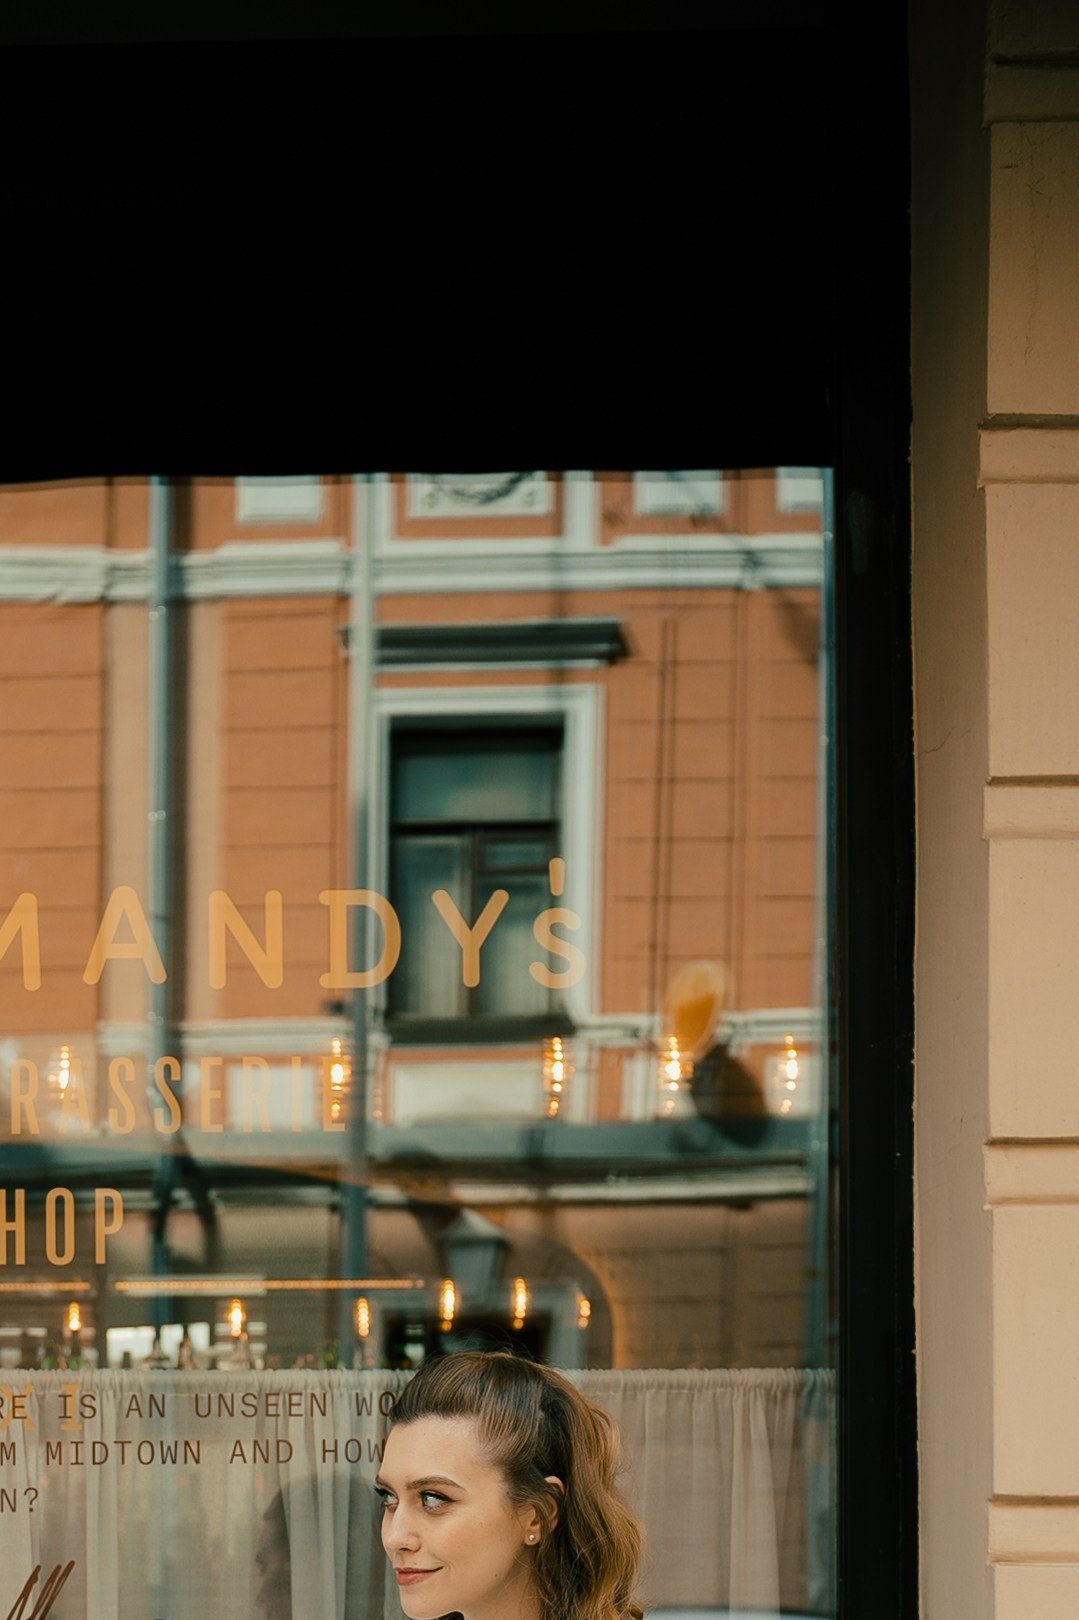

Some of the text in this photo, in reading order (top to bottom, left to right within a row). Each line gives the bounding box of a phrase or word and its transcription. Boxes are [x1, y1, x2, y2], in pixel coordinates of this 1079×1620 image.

[58, 1393, 97, 1419] IS
[125, 1393, 166, 1418] AN
[194, 1392, 327, 1418] UNSEEN
[355, 1391, 397, 1417] WO
[46, 1440, 201, 1466] MIDTOWN
[229, 1439, 293, 1465] AND
